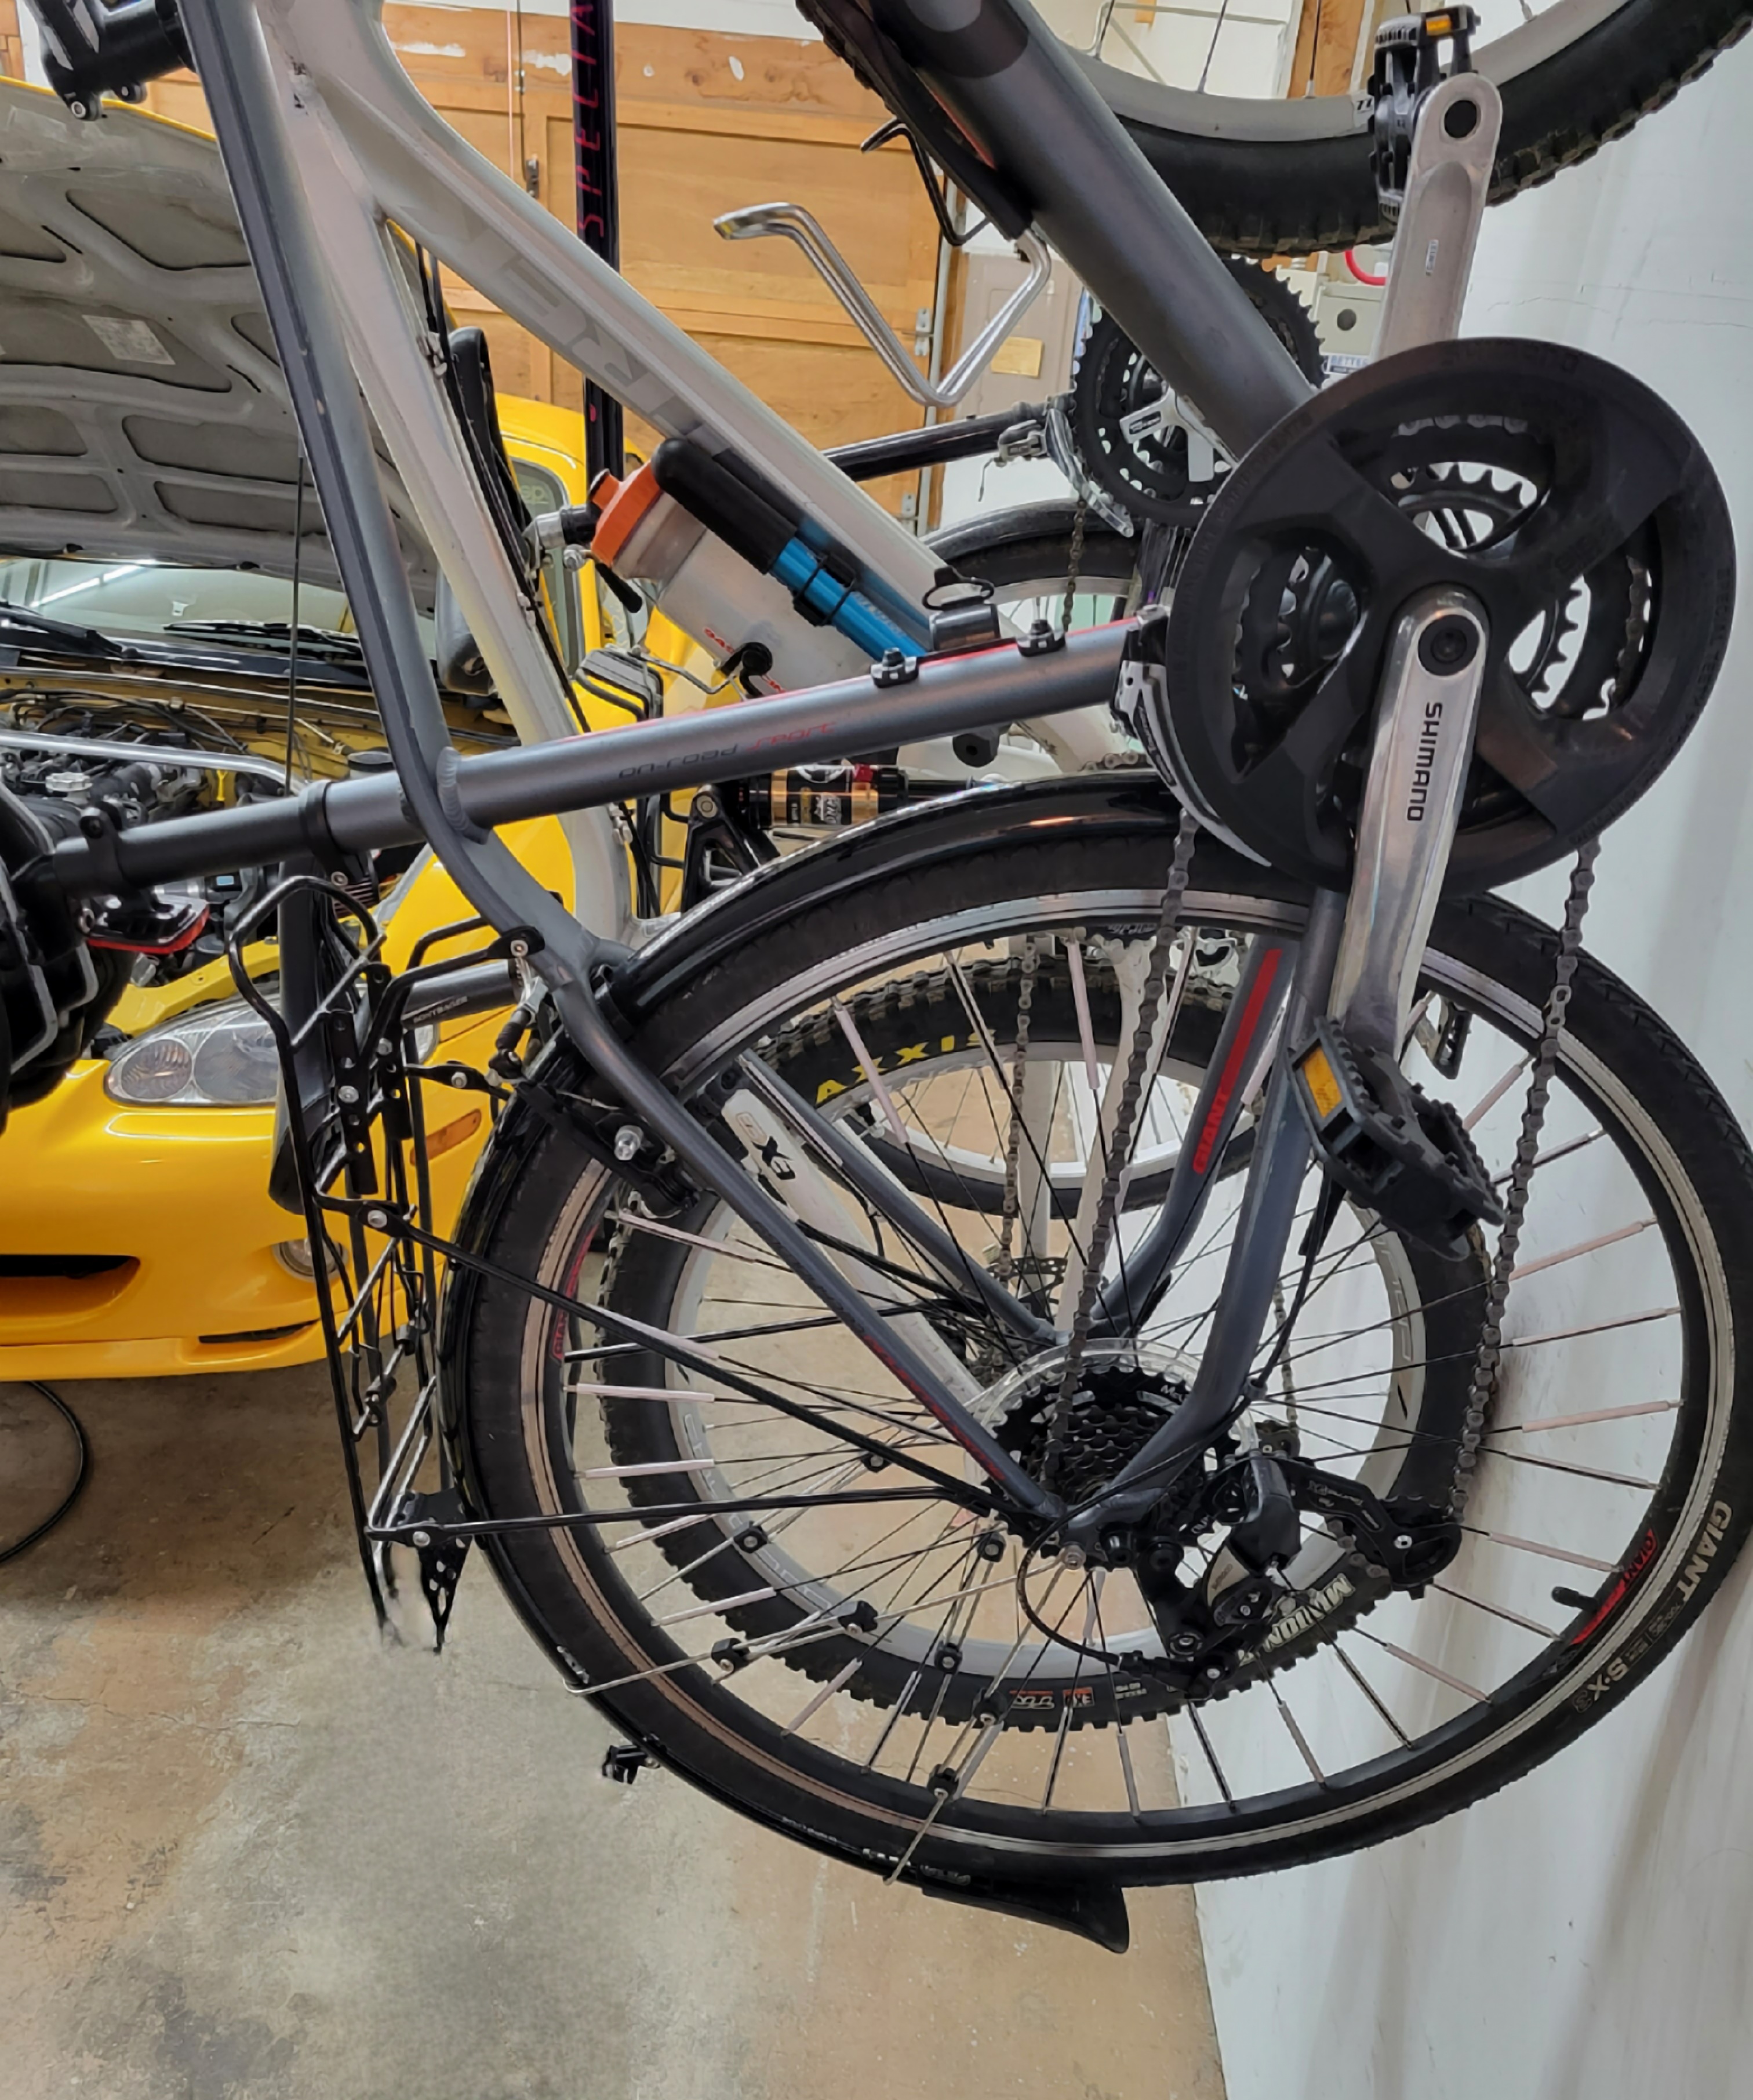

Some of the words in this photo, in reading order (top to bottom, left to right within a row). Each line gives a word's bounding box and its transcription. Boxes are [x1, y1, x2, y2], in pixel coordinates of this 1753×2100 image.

[618, 743, 739, 779] on-road
[745, 722, 835, 751] sport
[1407, 702, 1443, 821] SHIMANO
[816, 1029, 996, 1105] AXXIS
[1676, 1499, 1733, 1602] GIANT
